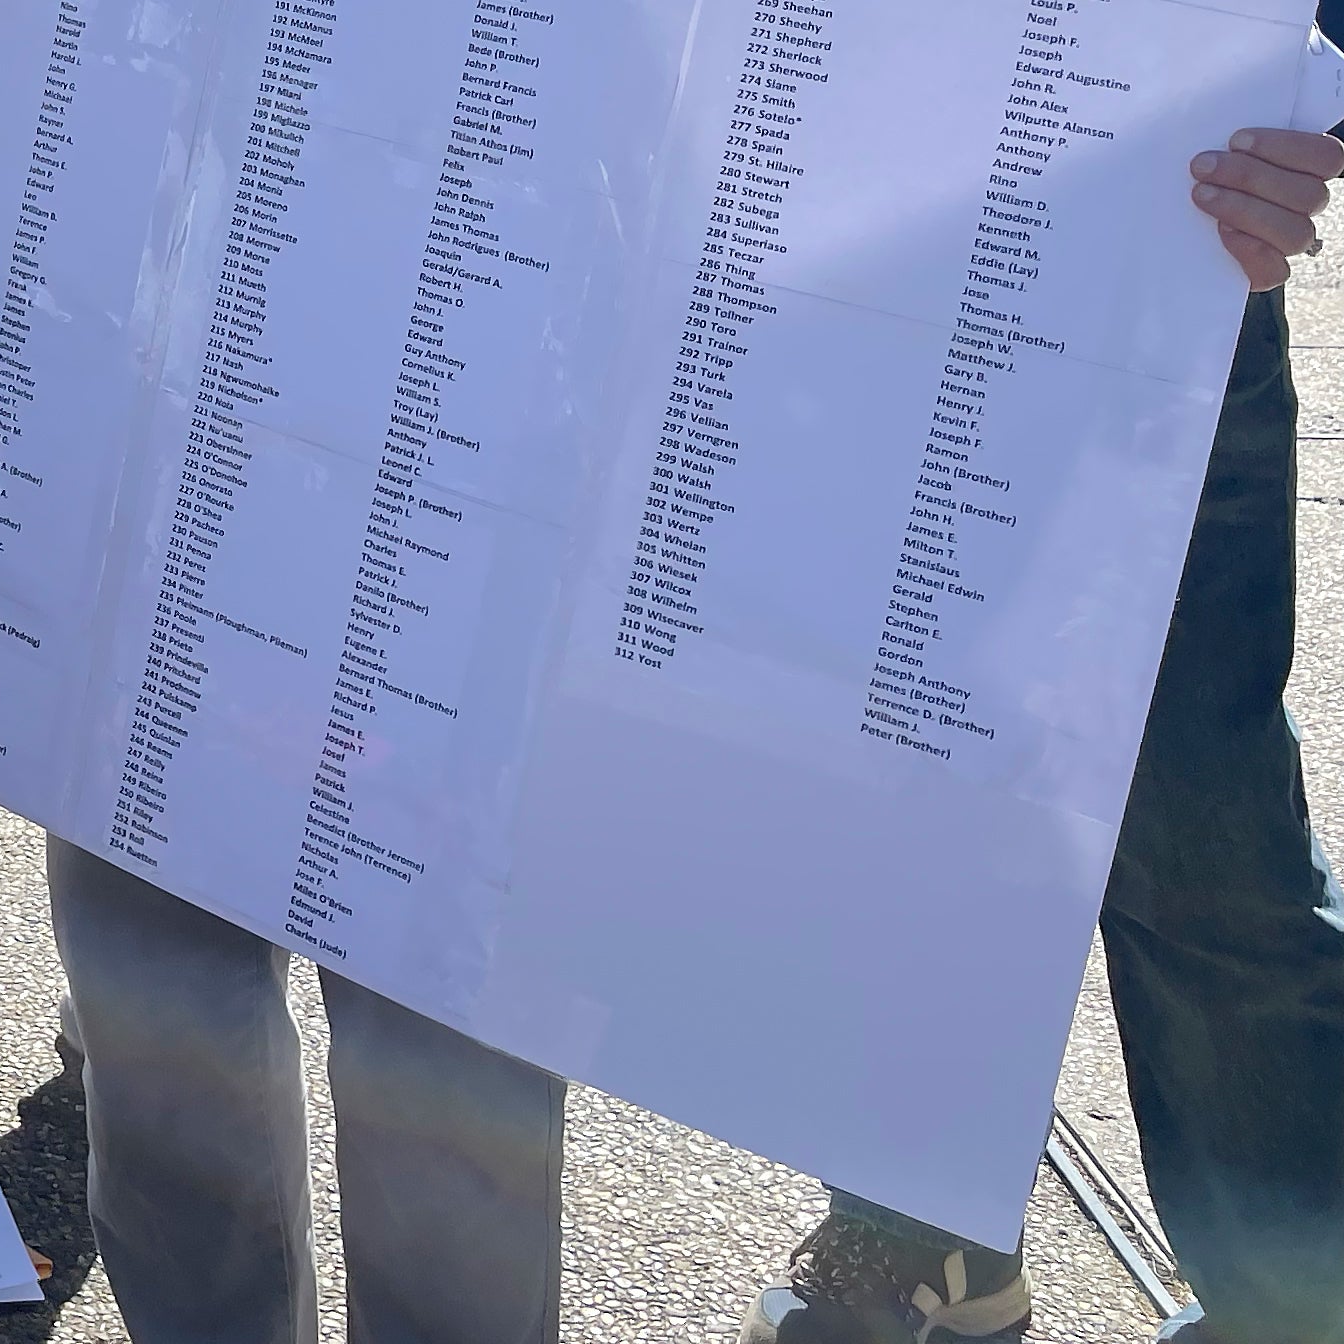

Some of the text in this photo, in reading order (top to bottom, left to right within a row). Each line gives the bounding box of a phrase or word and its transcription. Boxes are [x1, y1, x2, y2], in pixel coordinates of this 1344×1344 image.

[891, 583, 935, 604] Gerald
[888, 599, 939, 622] Stephen
[614, 646, 662, 670] 312 Yost
